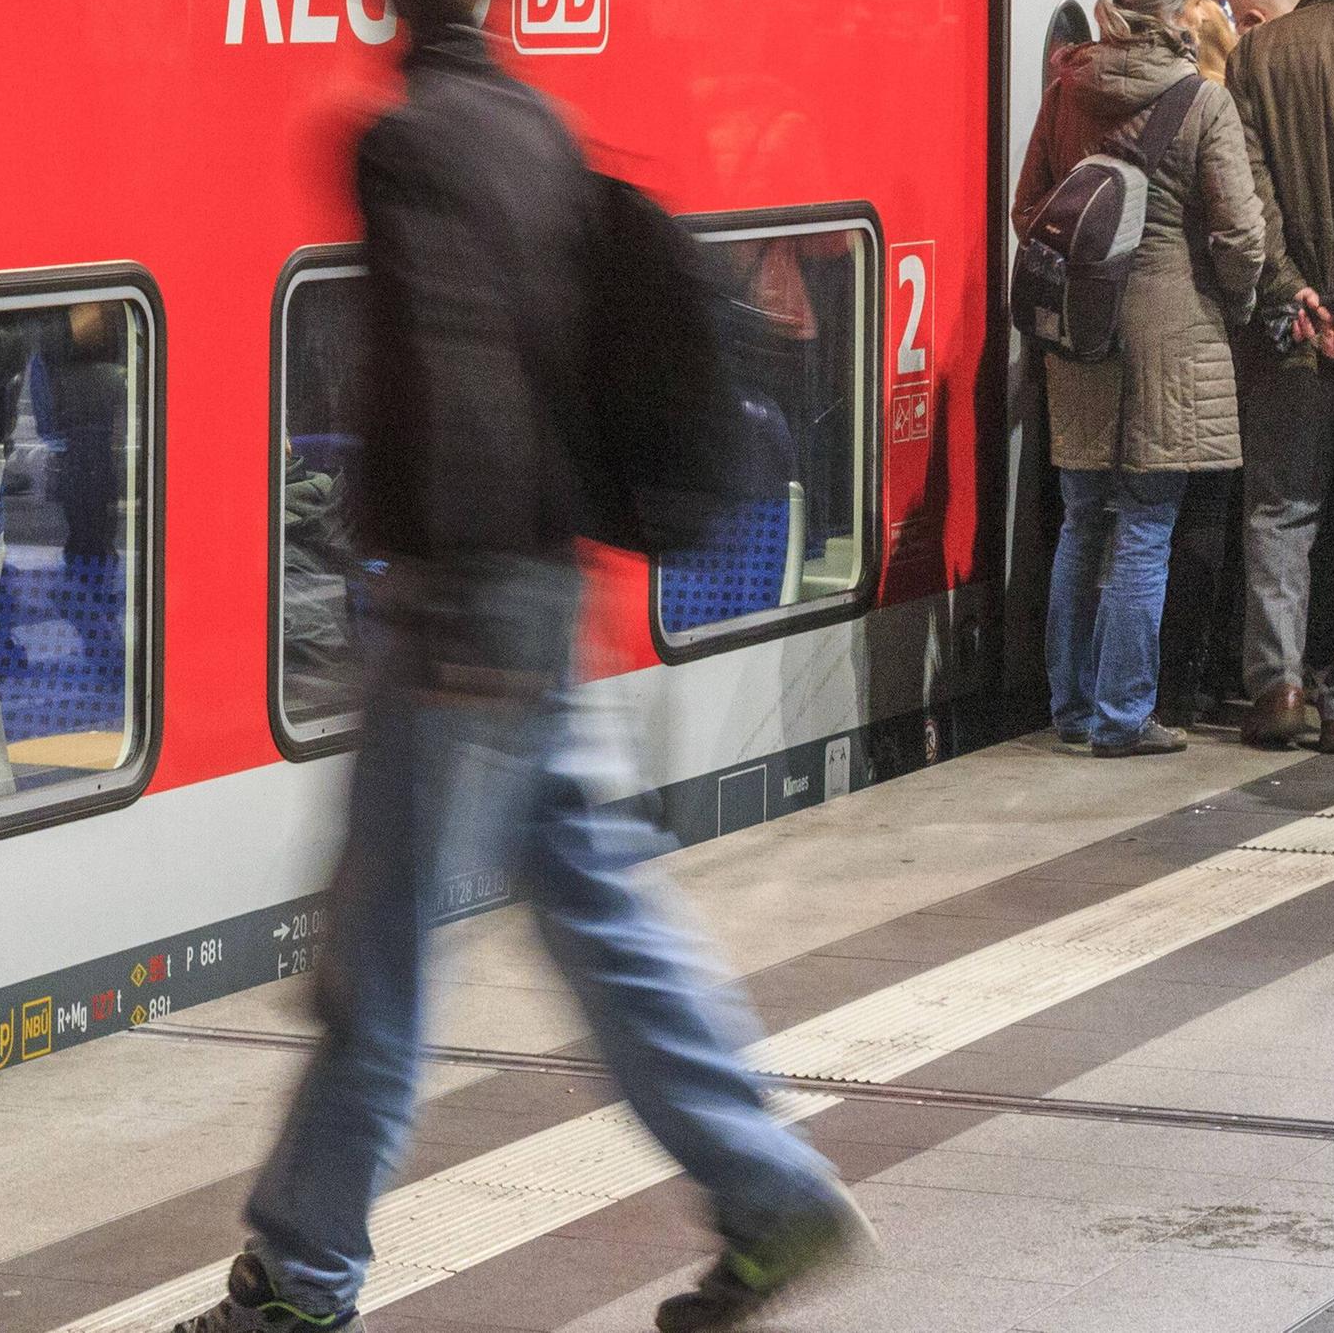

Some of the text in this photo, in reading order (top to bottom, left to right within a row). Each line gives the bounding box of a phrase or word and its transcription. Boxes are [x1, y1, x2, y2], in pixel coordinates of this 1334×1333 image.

[897, 254, 927, 375] 2
[187, 946, 194, 972] P
[25, 1008, 49, 1039] NBÜ
[57, 1001, 87, 1034] R+Mg
